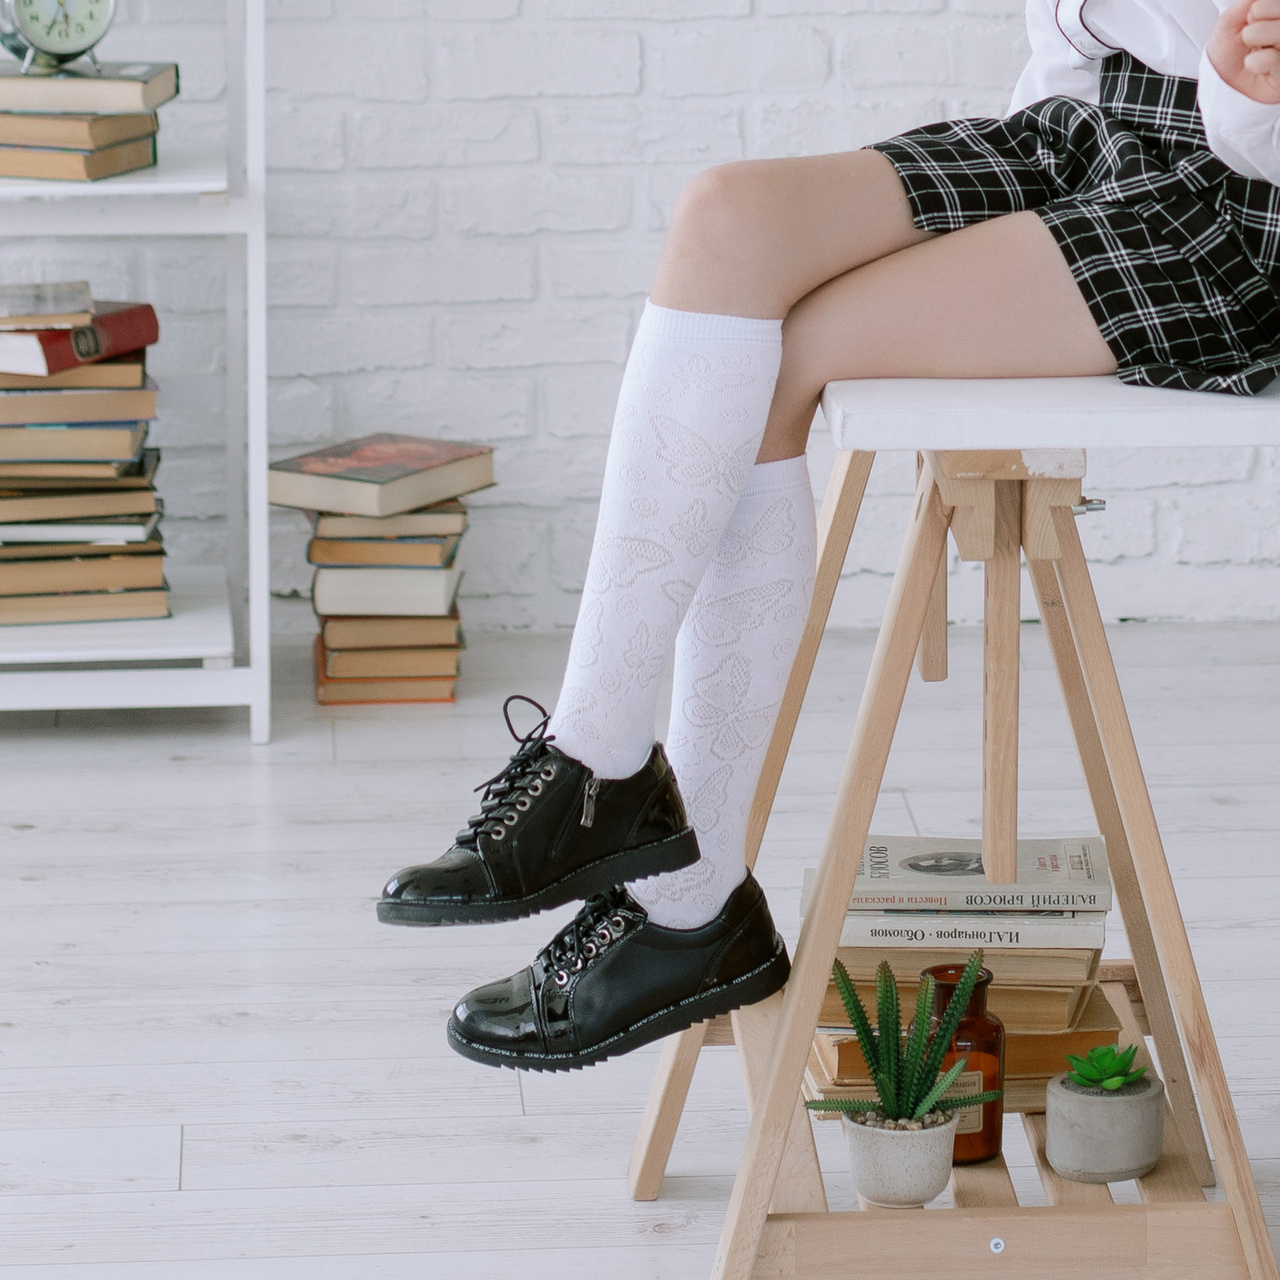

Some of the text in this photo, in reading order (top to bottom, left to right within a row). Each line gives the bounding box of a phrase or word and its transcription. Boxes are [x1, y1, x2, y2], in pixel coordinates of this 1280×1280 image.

[907, 896, 948, 906] Повести
[965, 894, 1024, 906] БРЮСОВ
[1031, 893, 1097, 908] ВАЛЕРИЙ
[870, 928, 925, 942] Обломов
